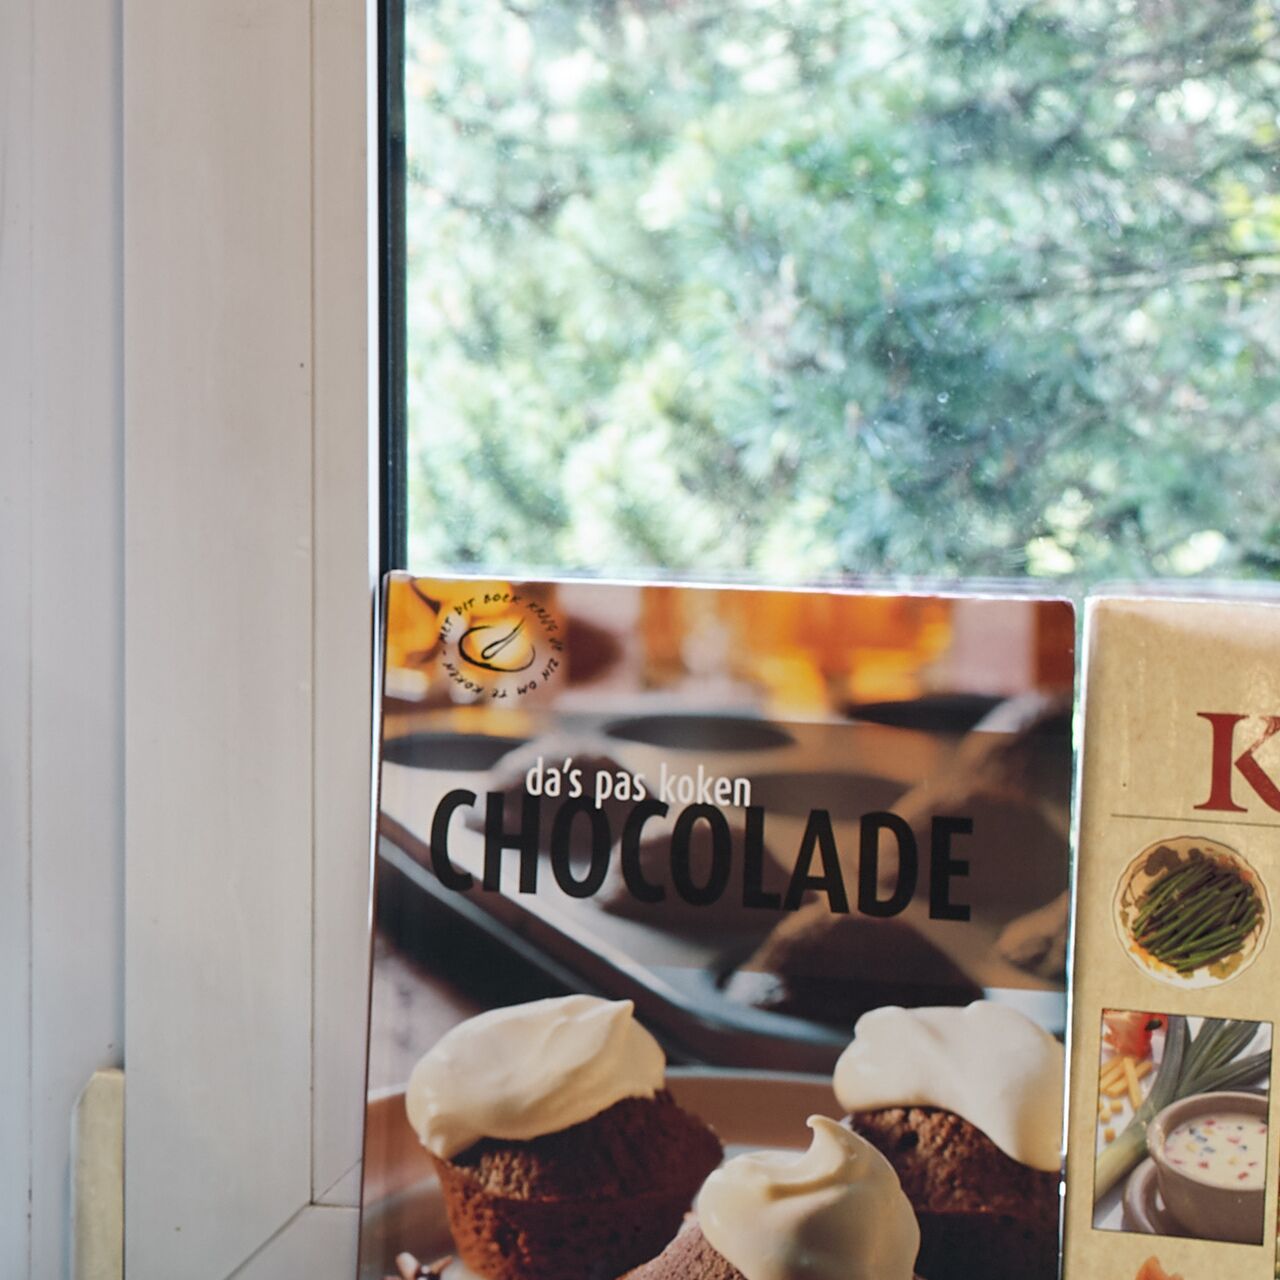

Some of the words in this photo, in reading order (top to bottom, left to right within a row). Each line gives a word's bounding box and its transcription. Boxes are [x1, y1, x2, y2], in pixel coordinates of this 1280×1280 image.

[594, 768, 646, 810] pas
[659, 762, 752, 807] koken
[430, 788, 974, 922] CHOCOLADE
